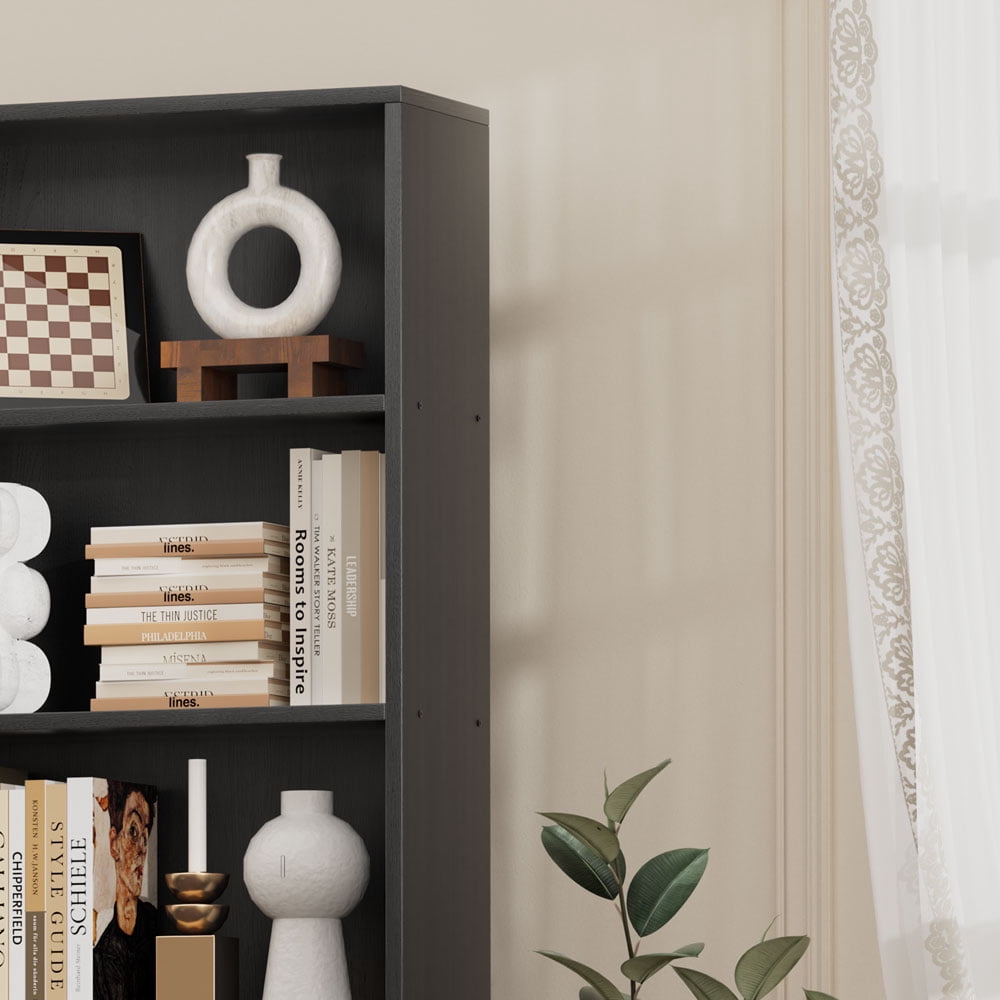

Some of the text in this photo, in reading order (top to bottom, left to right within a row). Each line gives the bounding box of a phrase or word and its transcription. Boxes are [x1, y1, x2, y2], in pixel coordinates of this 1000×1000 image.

[163, 542, 195, 554] lines.
[141, 609, 218, 623] THE THIN JUSTICE
[163, 591, 195, 602] lines.
[291, 529, 308, 695] Rooms to Inspire
[327, 548, 337, 630] KATE MOSS
[345, 555, 358, 618] LEADERSHIP
[141, 631, 208, 642] PHILADELPHIA
[168, 696, 201, 708] lines.
[11, 851, 23, 946] CHIPPERFIELD
[50, 821, 64, 991] STYLE GUIDE
[70, 837, 87, 936] SCHIELE
